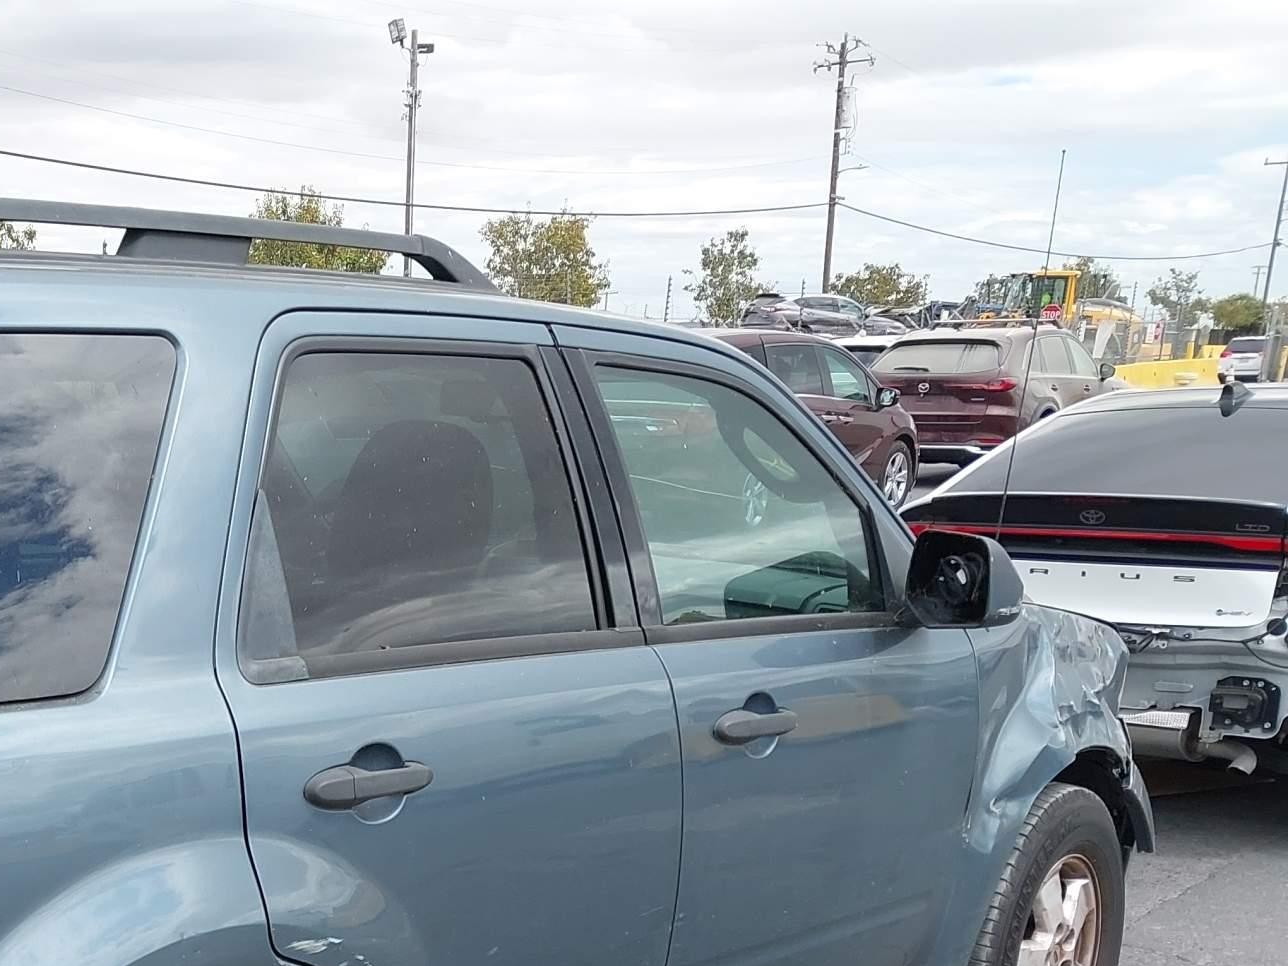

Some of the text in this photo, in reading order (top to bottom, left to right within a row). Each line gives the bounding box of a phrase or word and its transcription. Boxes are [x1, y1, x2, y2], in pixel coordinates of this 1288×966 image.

[1042, 310, 1061, 320] STOP
[1235, 523, 1271, 533] LTD
[1029, 567, 1196, 584] RIUS
